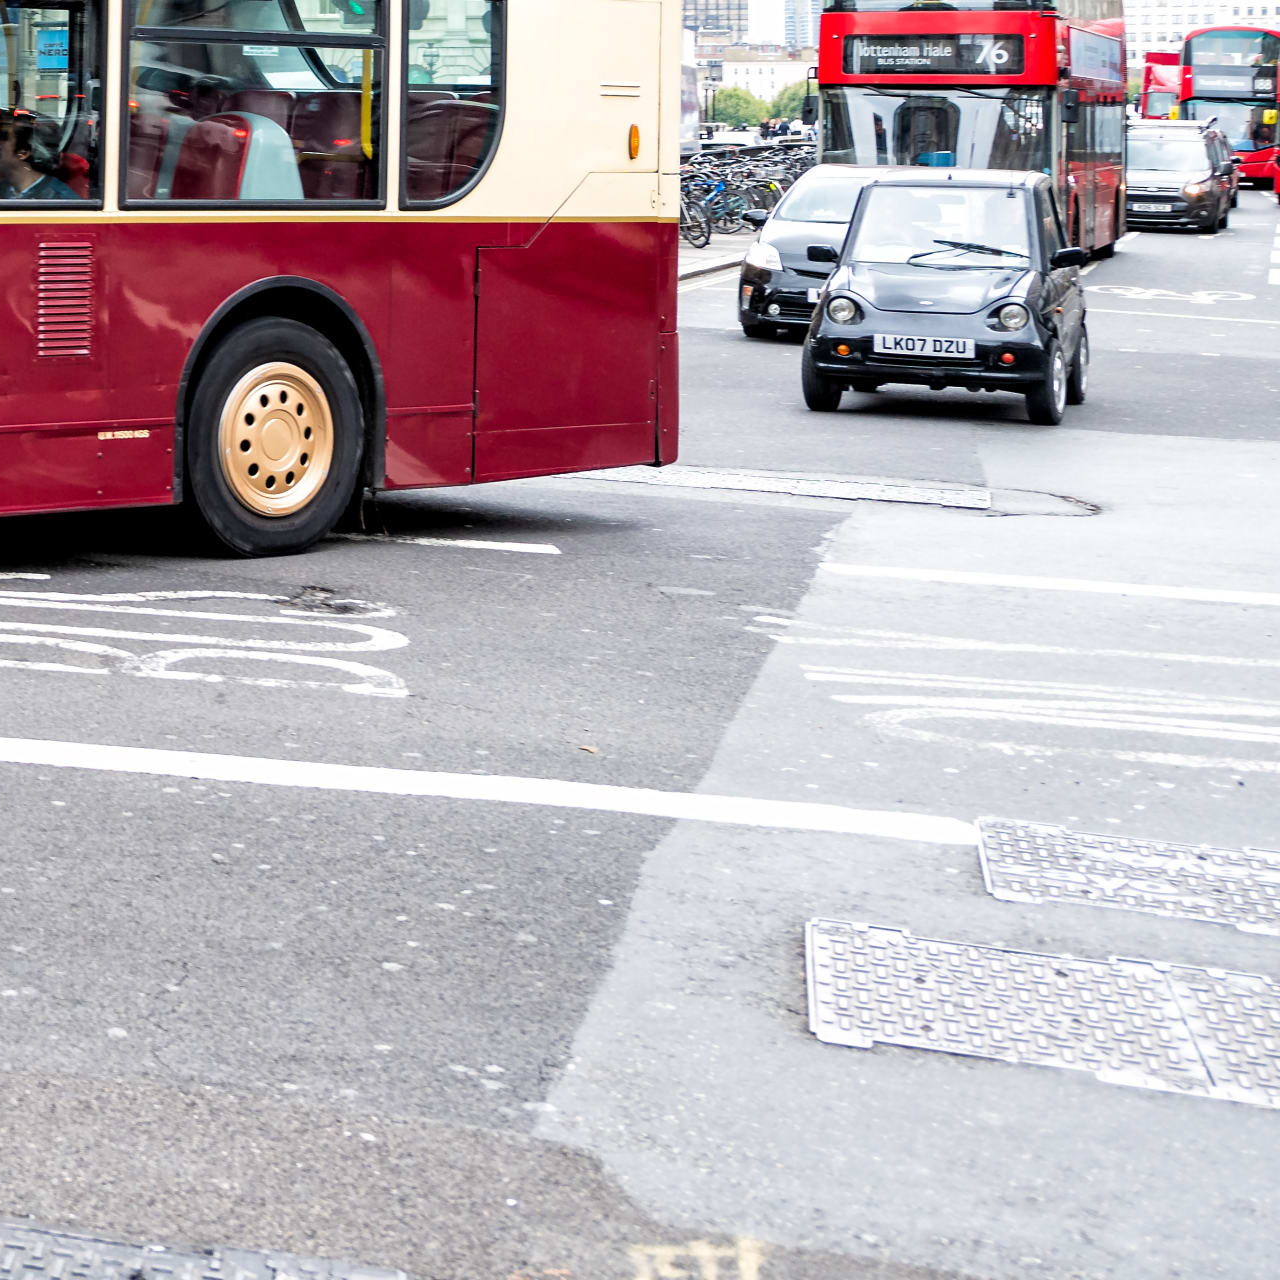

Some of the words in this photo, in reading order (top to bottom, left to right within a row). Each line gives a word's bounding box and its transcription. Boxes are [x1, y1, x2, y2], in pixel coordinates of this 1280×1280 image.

[858, 39, 920, 58] Tottenham
[923, 42, 953, 58] Hale
[975, 40, 1010, 65] 76
[895, 57, 932, 65] STATION
[881, 336, 926, 353] LK07
[932, 339, 967, 354] DZU
